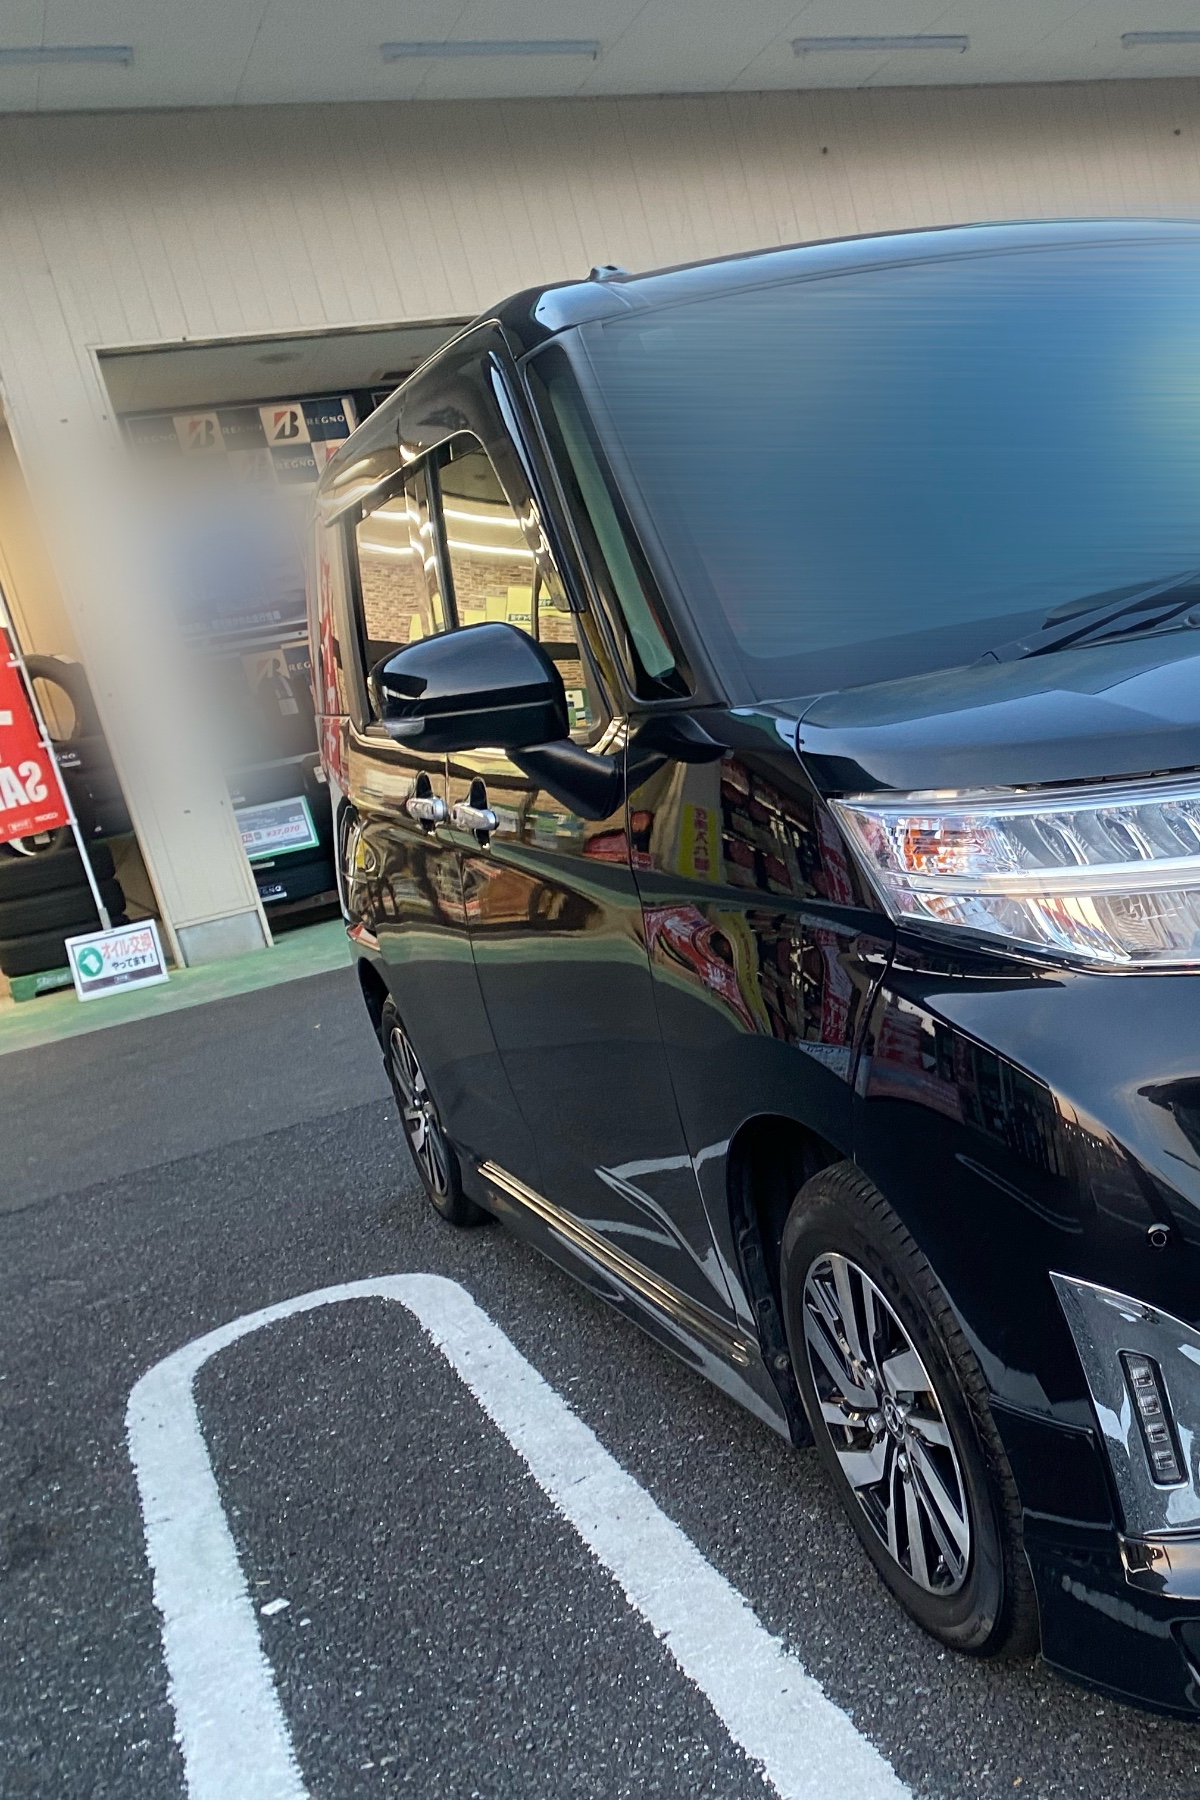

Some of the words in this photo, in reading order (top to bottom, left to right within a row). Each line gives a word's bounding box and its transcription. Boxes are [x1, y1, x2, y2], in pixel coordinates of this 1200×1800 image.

[306, 414, 346, 426] REGNO
[102, 932, 153, 960] オイル交換
